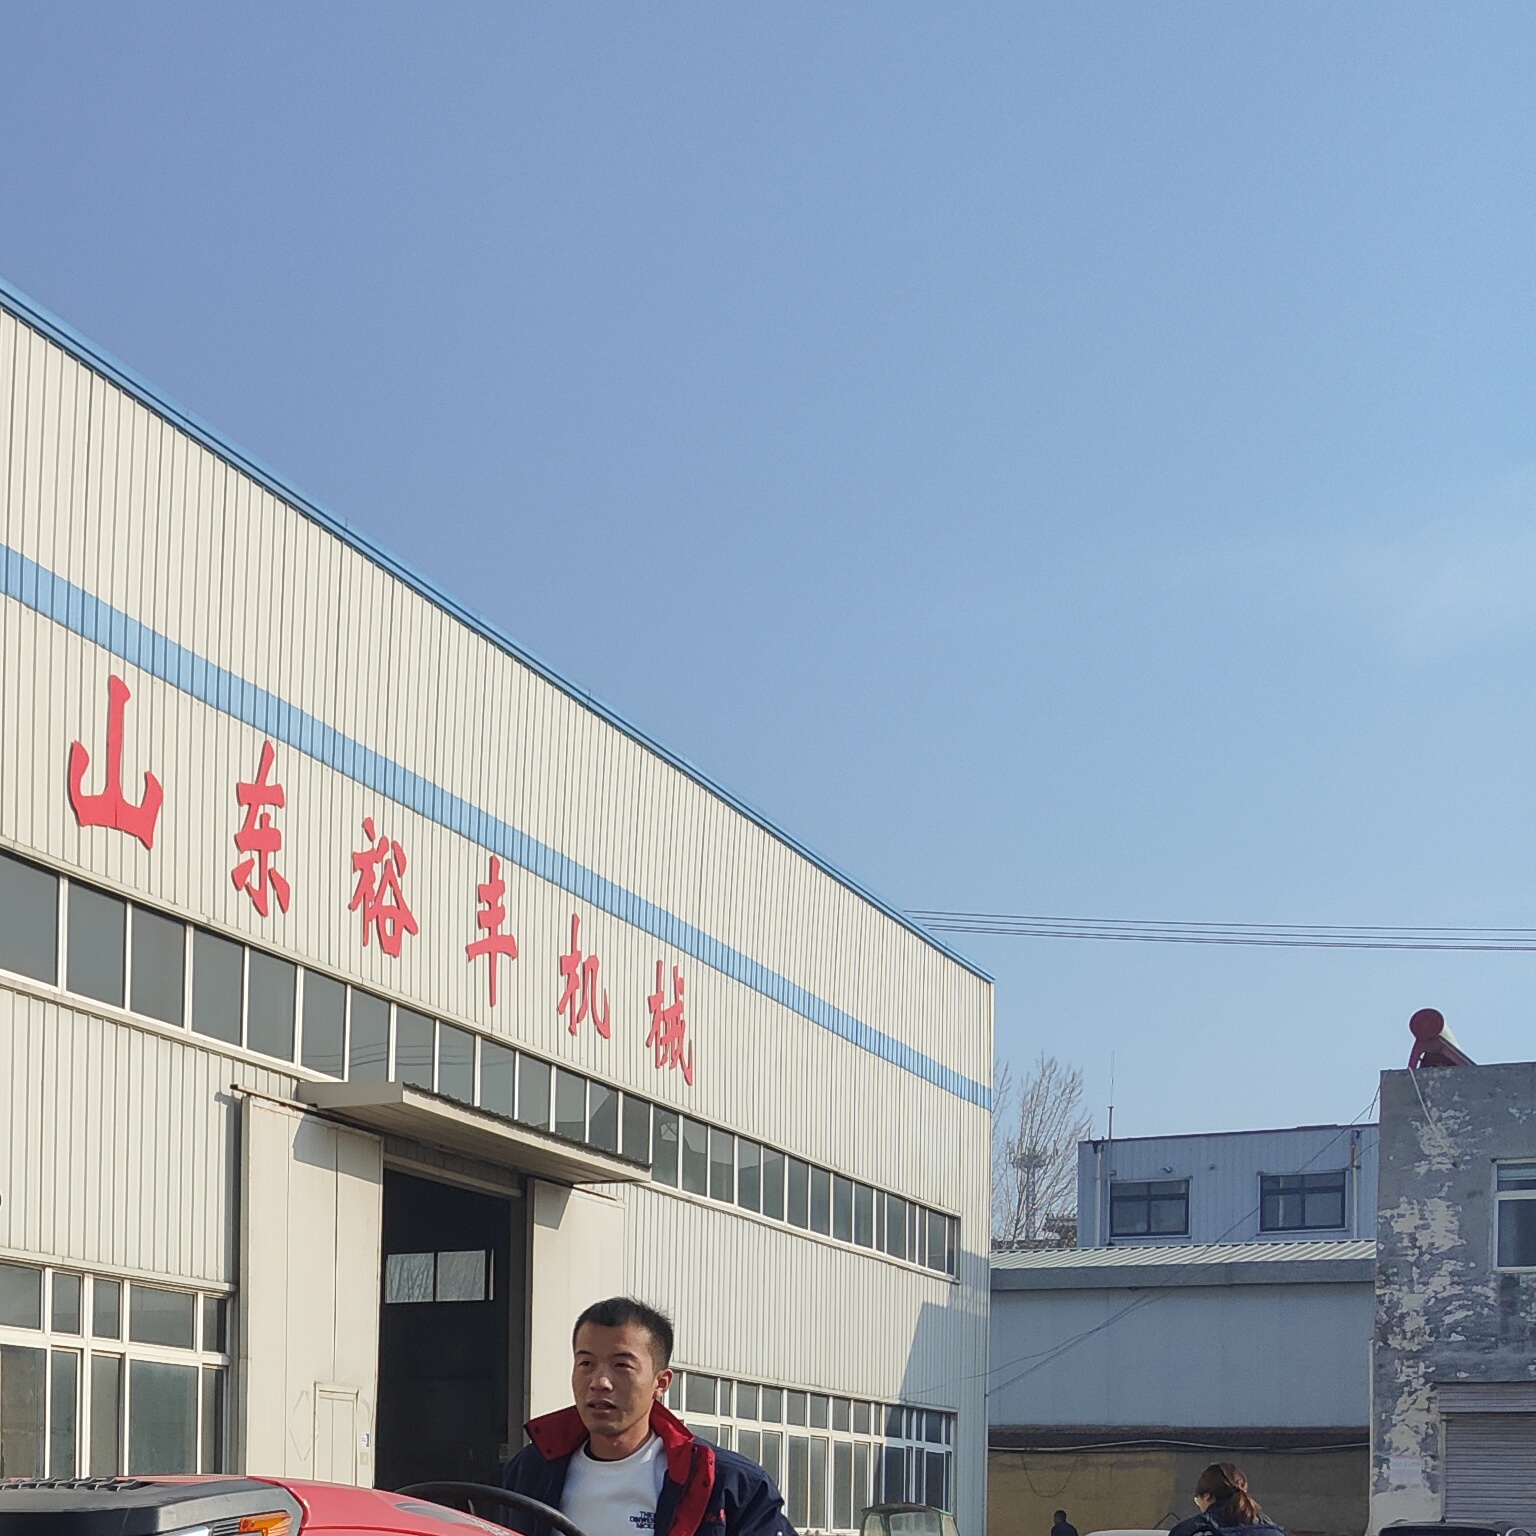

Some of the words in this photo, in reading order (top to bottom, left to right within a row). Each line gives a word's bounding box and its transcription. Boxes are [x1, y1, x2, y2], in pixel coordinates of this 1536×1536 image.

[68, 674, 693, 1086] 山东裕丰机械
